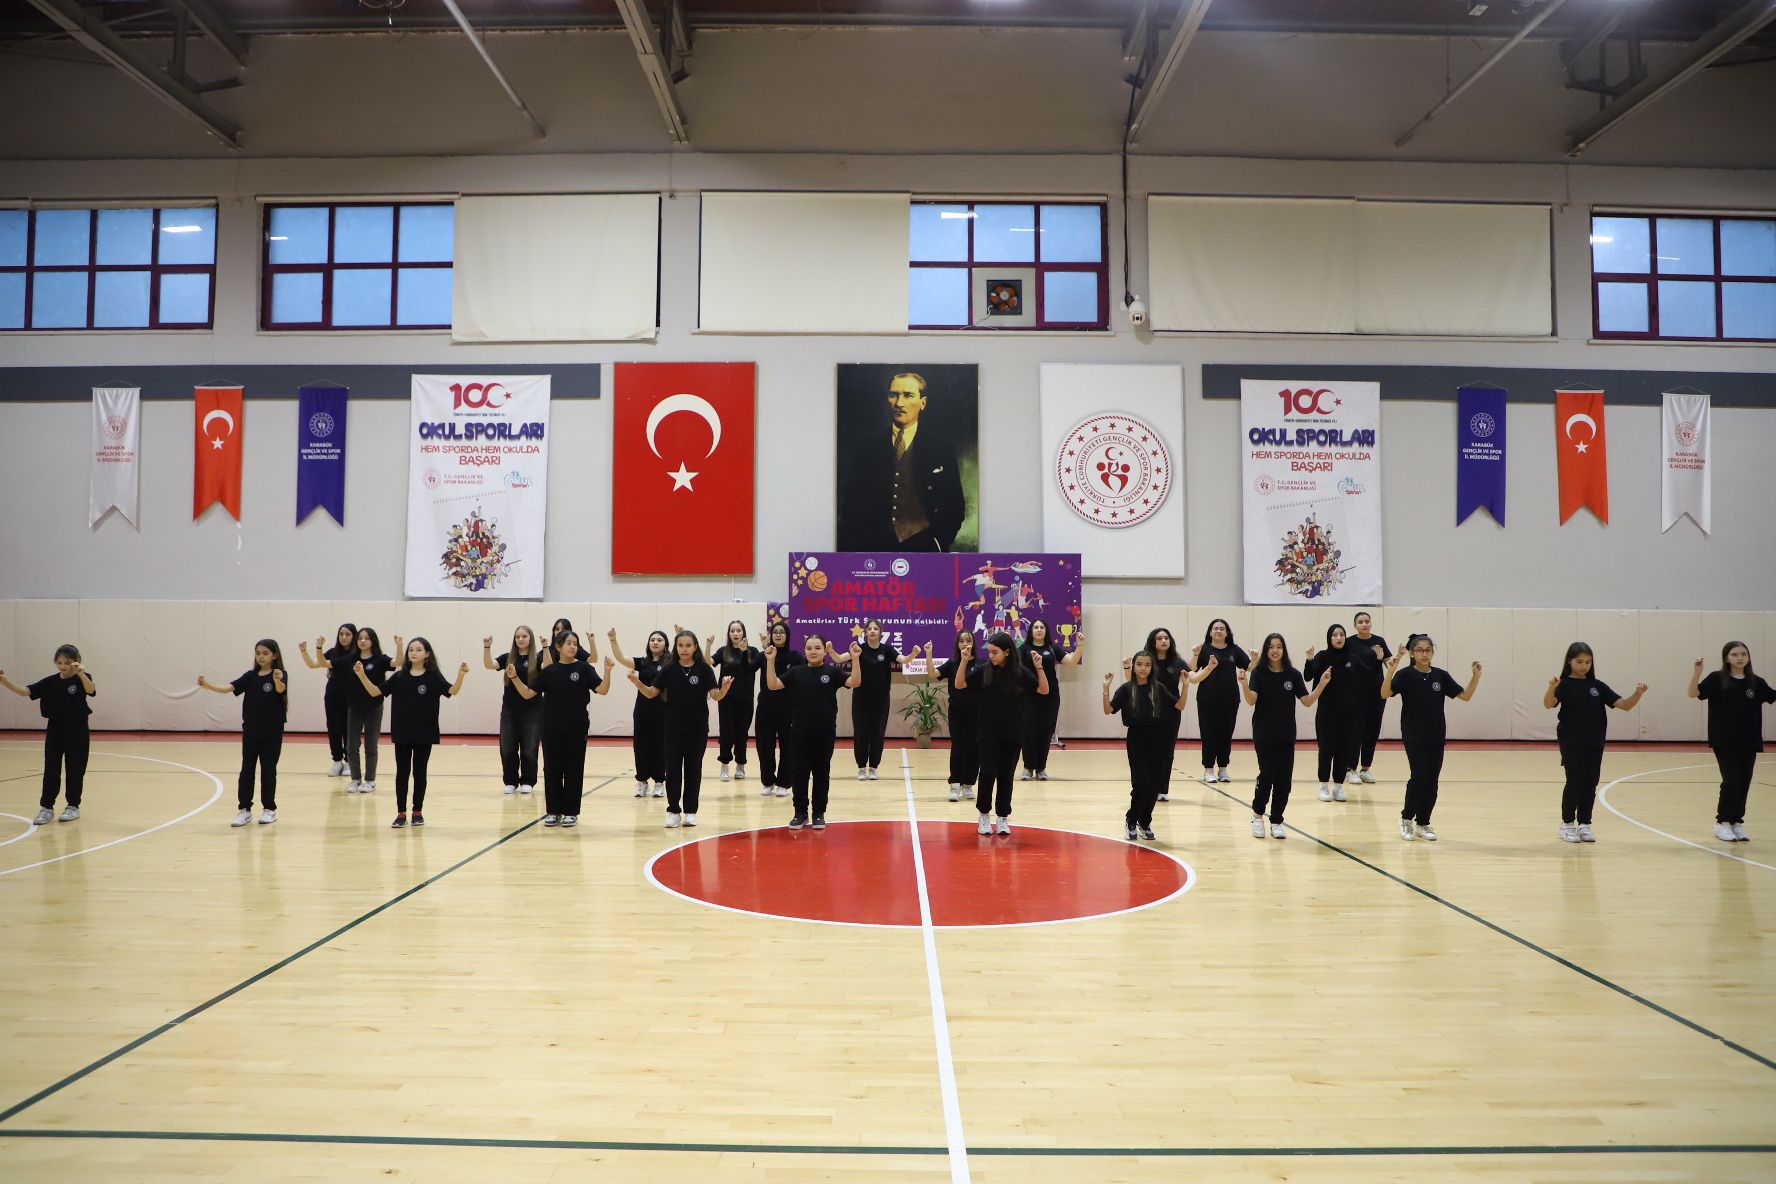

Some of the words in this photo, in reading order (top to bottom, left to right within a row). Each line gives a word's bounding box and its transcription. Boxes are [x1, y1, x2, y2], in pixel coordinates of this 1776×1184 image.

[419, 422, 463, 440] OKUL
[464, 422, 545, 440] SPORLARI
[1249, 427, 1294, 446] OKUL
[1296, 428, 1375, 448] SPORLARI
[1103, 435, 1132, 445] GENÇLİK
[1133, 444, 1141, 452] VE
[421, 445, 440, 454] HEM
[442, 445, 479, 454] SPORDA
[481, 445, 501, 454] HEM
[503, 445, 540, 454] OKULDA
[1251, 451, 1273, 459] HEM
[1274, 451, 1311, 460] SPORDA
[1312, 452, 1333, 460] HEM
[1335, 452, 1371, 461] OKULDA
[459, 455, 501, 467] BAŞARI
[1079, 438, 1102, 481] CUMHURİYETİ
[1140, 453, 1149, 471] SPOR
[1291, 461, 1333, 473] BAŞARI
[1081, 482, 1105, 504] TÜRKİYE
[1123, 473, 1149, 503] BAKANLIĞI
[831, 576, 916, 596] AMATÖR
[803, 596, 857, 613] SPOR
[862, 596, 946, 613] HAFTASI
[838, 616, 860, 624] Türk
[914, 617, 948, 625] Kalbidir
